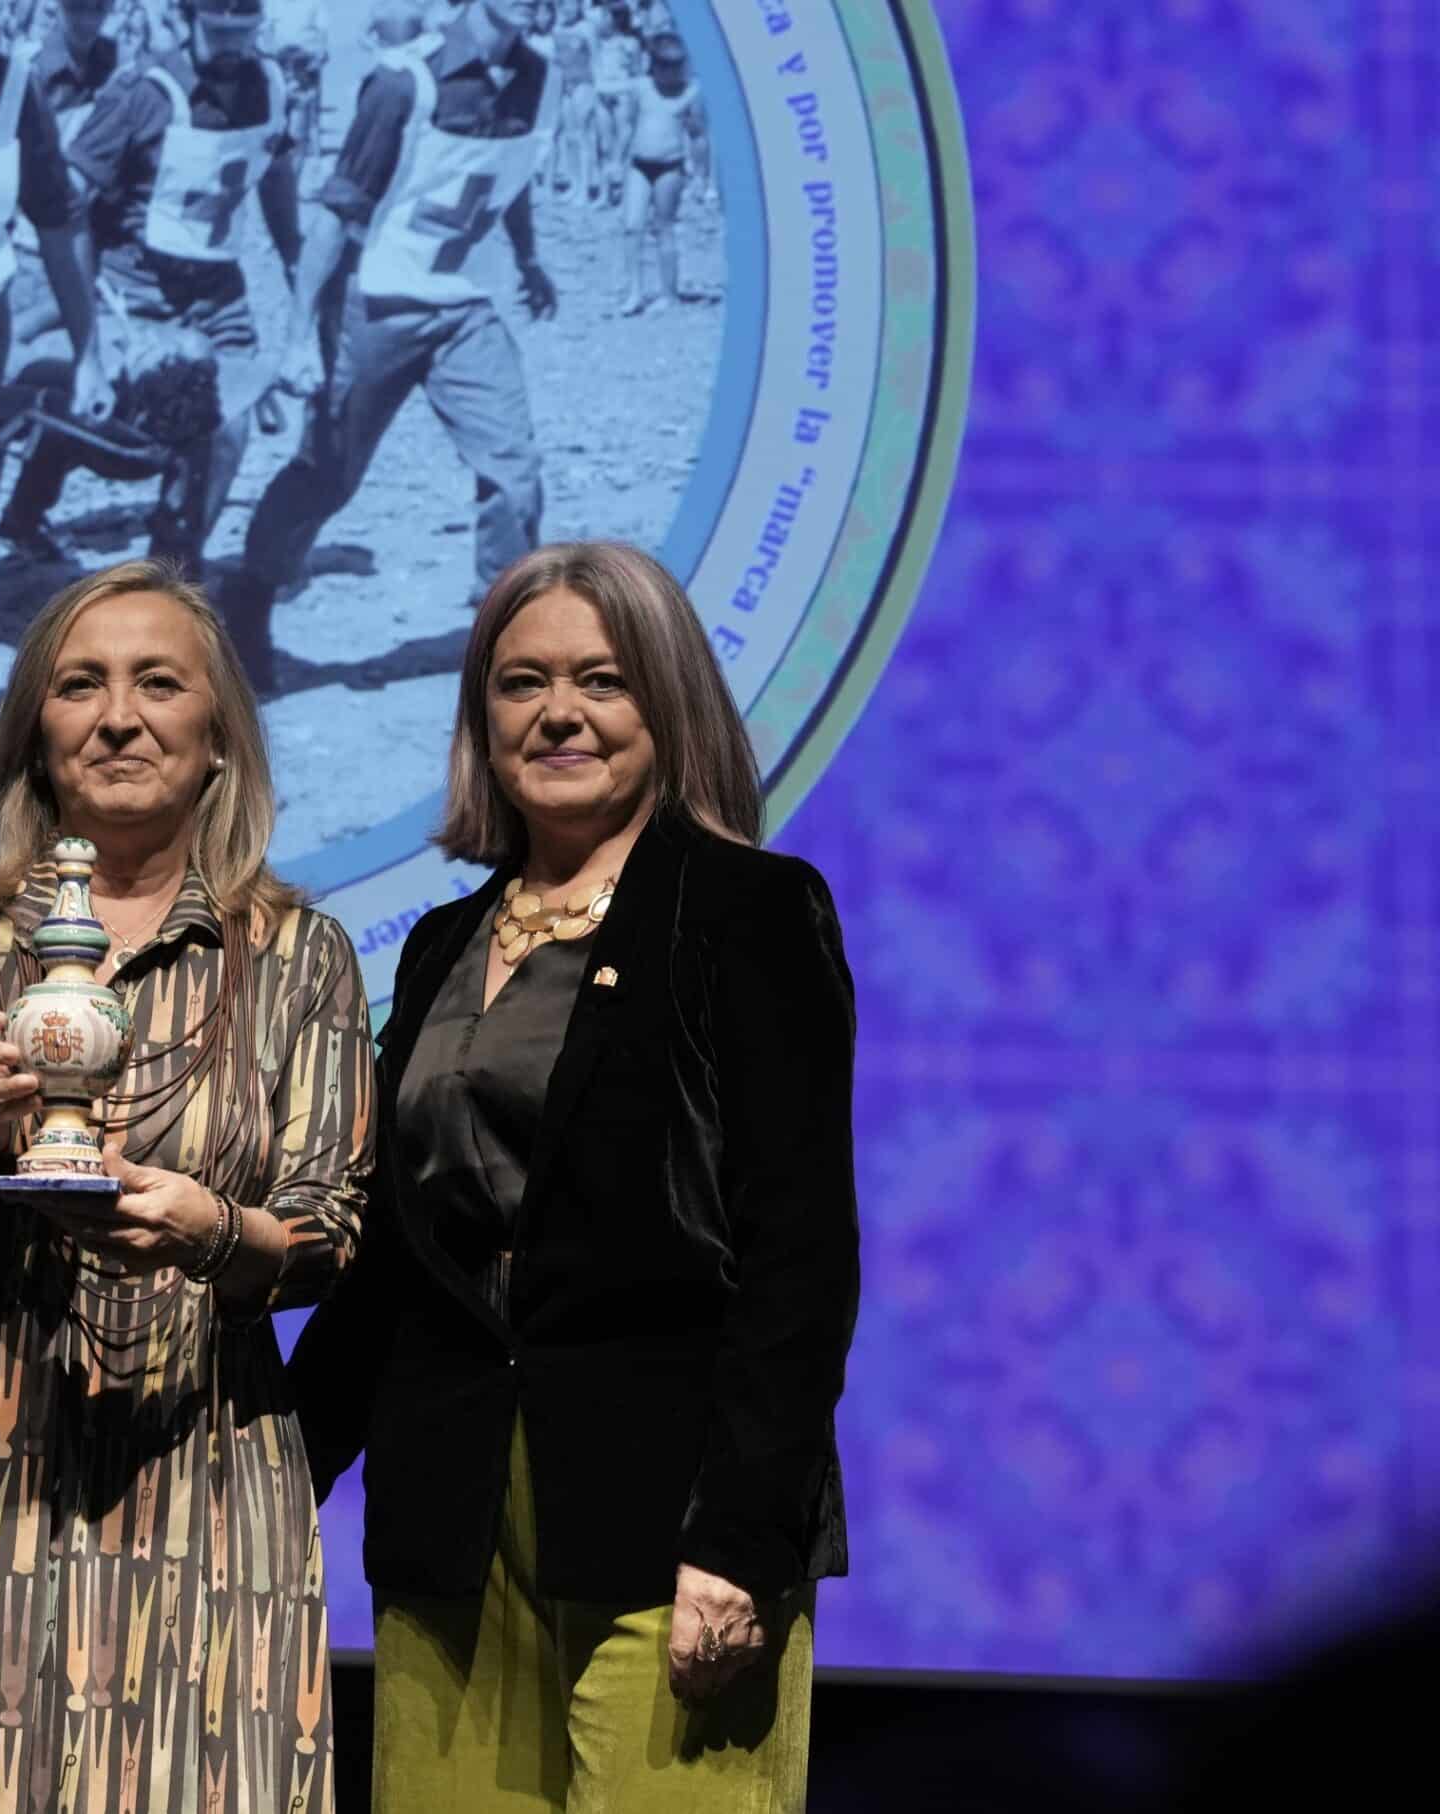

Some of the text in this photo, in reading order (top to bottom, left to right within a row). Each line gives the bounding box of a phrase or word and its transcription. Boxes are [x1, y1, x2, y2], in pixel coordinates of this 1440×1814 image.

[777, 52, 807, 75] y
[786, 93, 827, 162] por
[802, 182, 838, 390] promover
[793, 407, 832, 444] la
